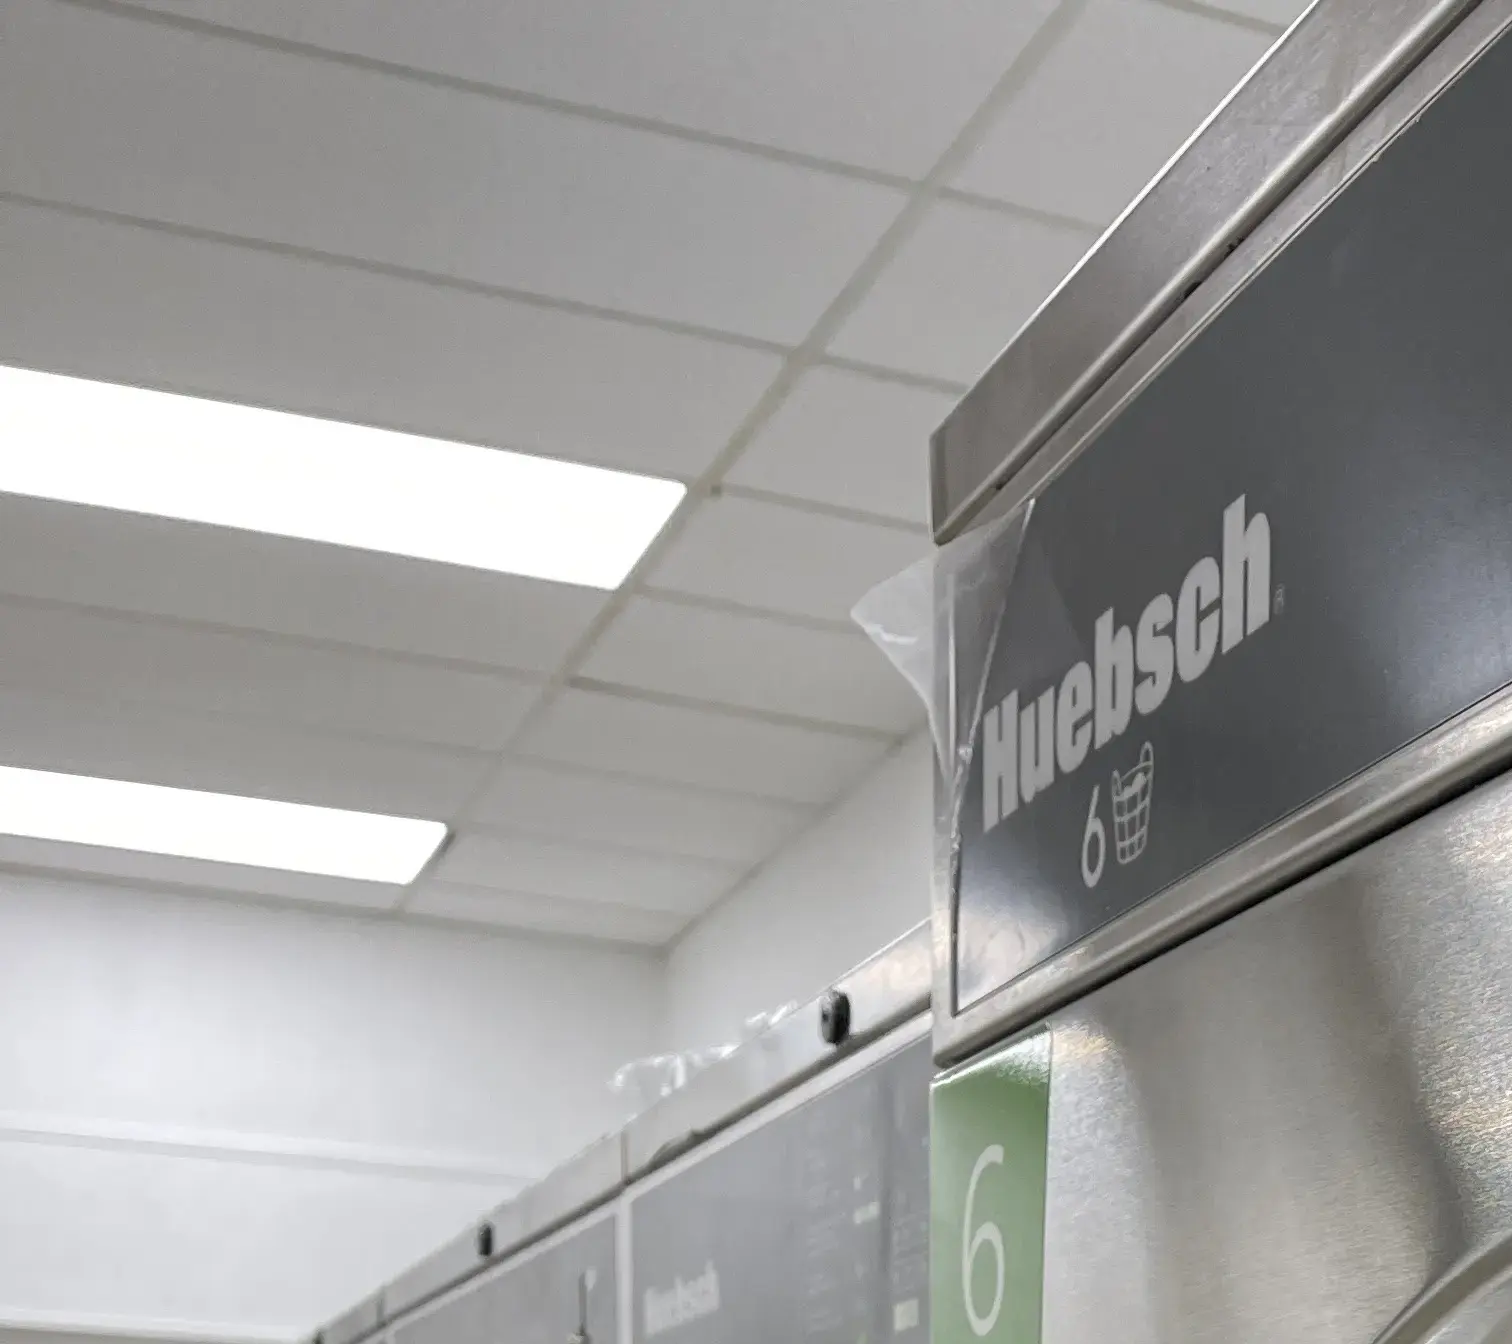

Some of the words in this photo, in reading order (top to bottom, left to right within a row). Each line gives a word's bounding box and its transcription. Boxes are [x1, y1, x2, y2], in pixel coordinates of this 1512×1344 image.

[981, 493, 1272, 834] Huebsch
[1081, 785, 1107, 889] 6
[961, 1143, 1005, 1337] 6
